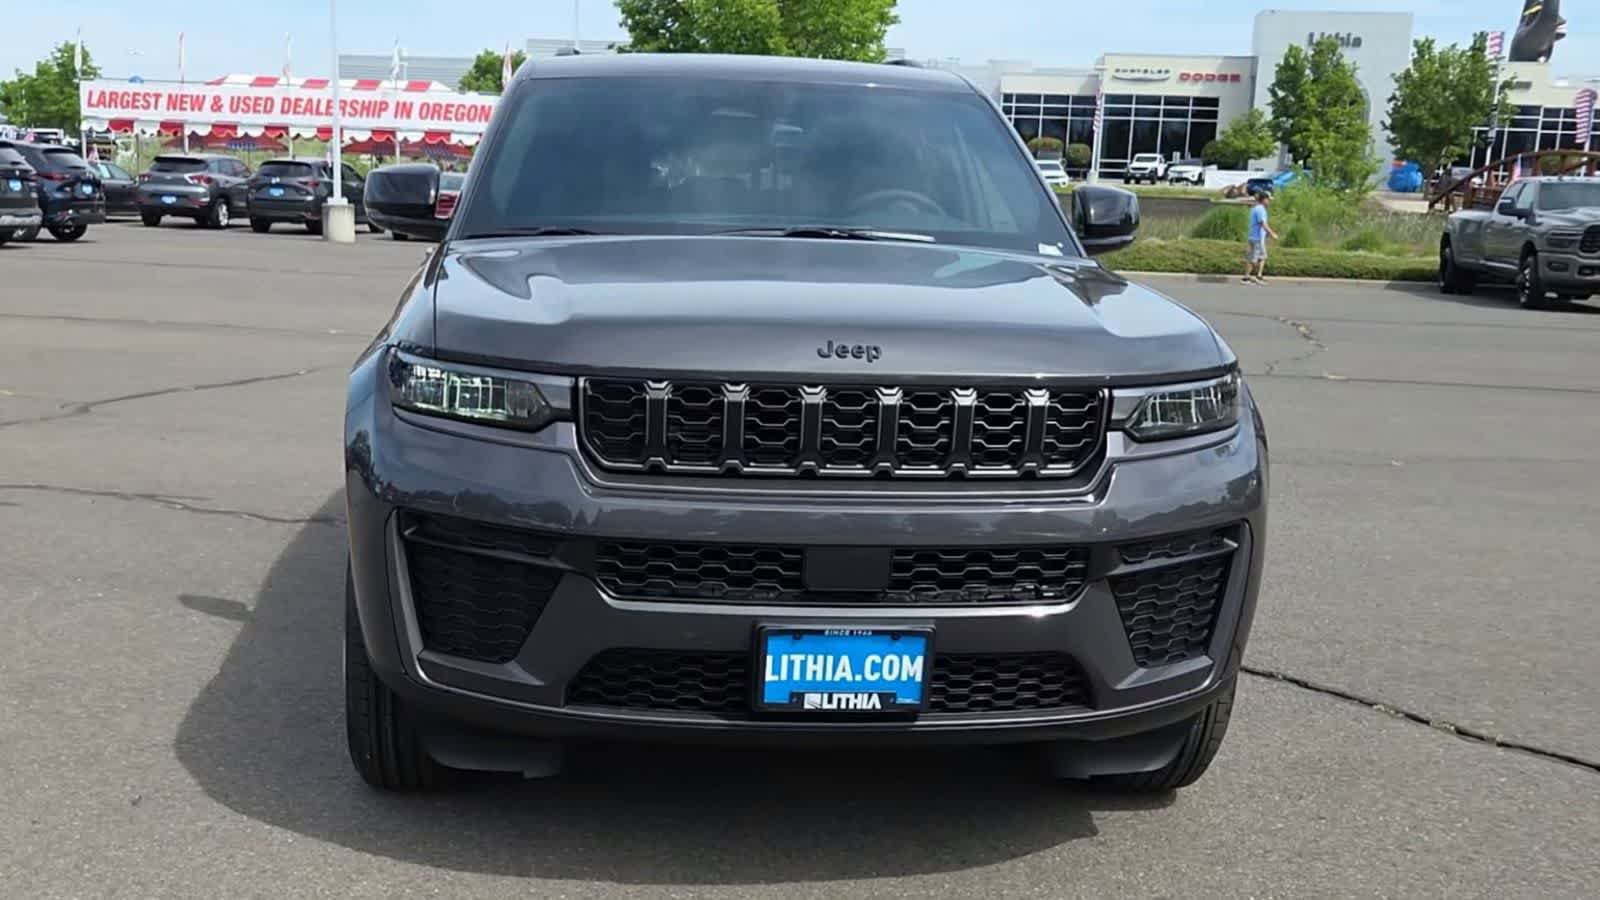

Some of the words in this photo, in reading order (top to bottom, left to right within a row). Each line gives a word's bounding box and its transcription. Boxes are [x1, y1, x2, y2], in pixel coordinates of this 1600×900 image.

[1179, 72, 1241, 82] DODGE
[87, 90, 162, 110] LARGEST
[166, 93, 207, 112] NEW
[210, 95, 224, 113] &
[229, 95, 275, 114] USED
[280, 97, 389, 119] DEALERSHIP
[394, 100, 413, 119] IN
[418, 102, 492, 123] OREGON
[816, 340, 882, 363] Jeep
[765, 654, 924, 682] LITHIA.COM
[822, 693, 882, 709] LITHIA
